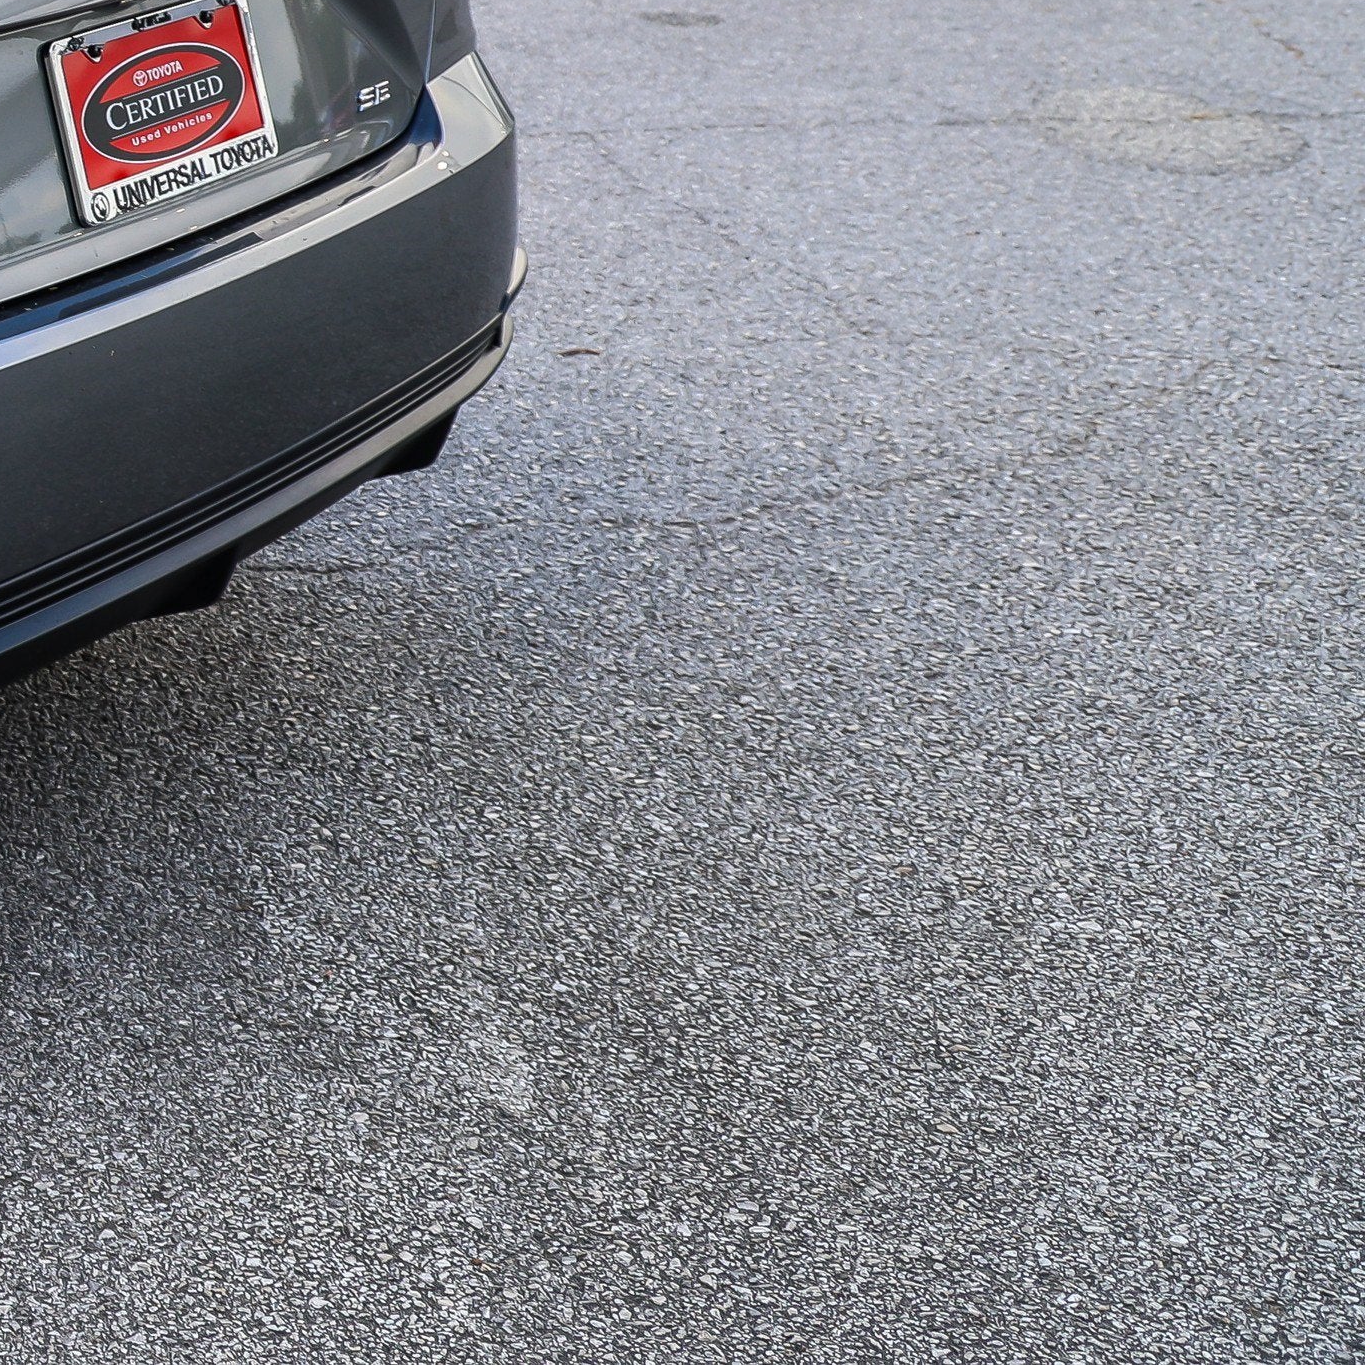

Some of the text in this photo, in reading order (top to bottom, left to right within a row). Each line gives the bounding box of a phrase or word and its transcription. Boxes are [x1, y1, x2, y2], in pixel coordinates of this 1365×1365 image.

[147, 60, 184, 82] TOYOTA
[105, 75, 224, 131] CERTIFIED
[356, 80, 392, 112] SE
[131, 112, 213, 146] Used Vehicles
[113, 135, 274, 212] UNIVERSAL TOYOTA
